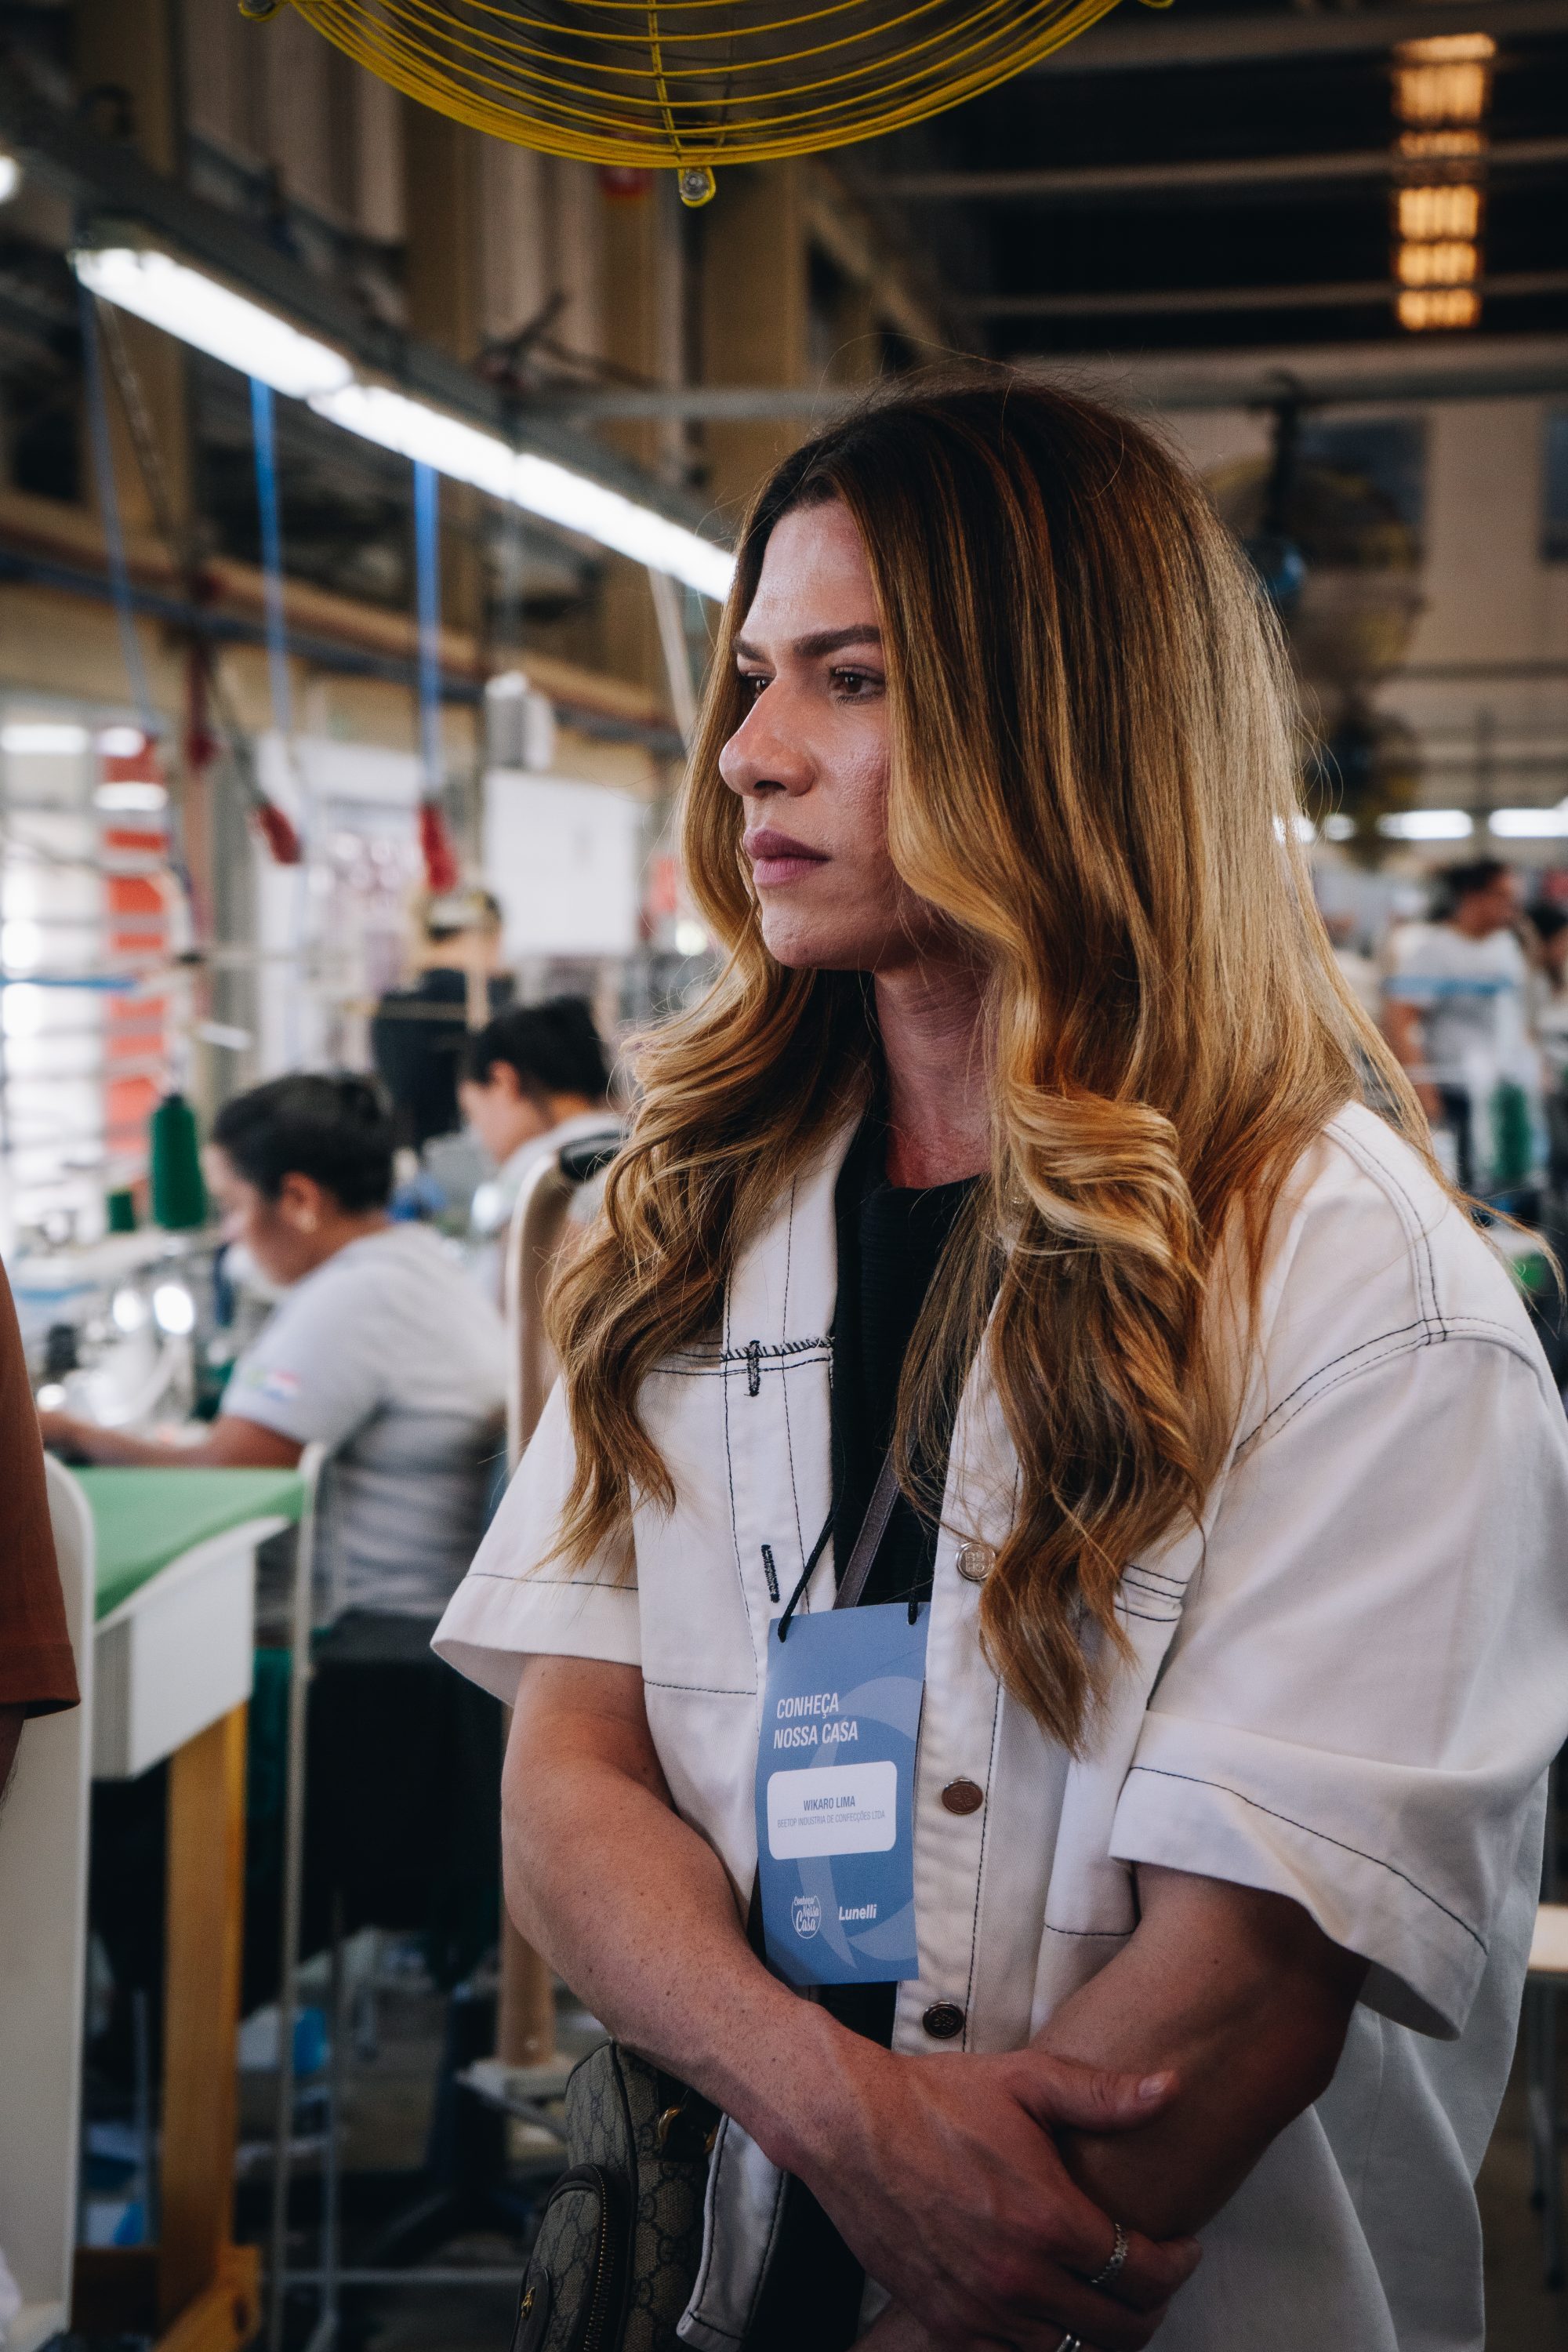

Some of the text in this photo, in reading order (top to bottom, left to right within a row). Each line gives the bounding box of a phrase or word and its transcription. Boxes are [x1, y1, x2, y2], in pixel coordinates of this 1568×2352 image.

[776, 1693, 839, 1719] CONHEÇA
[773, 1721, 858, 1749] NOSSA CASA
[803, 1795, 855, 1811] WIKARO LIMA
[827, 1814, 834, 1824] DE
[872, 1809, 885, 1820] LTDA
[796, 1910, 816, 1933] Casa
[838, 1904, 877, 1921] Lunelli
